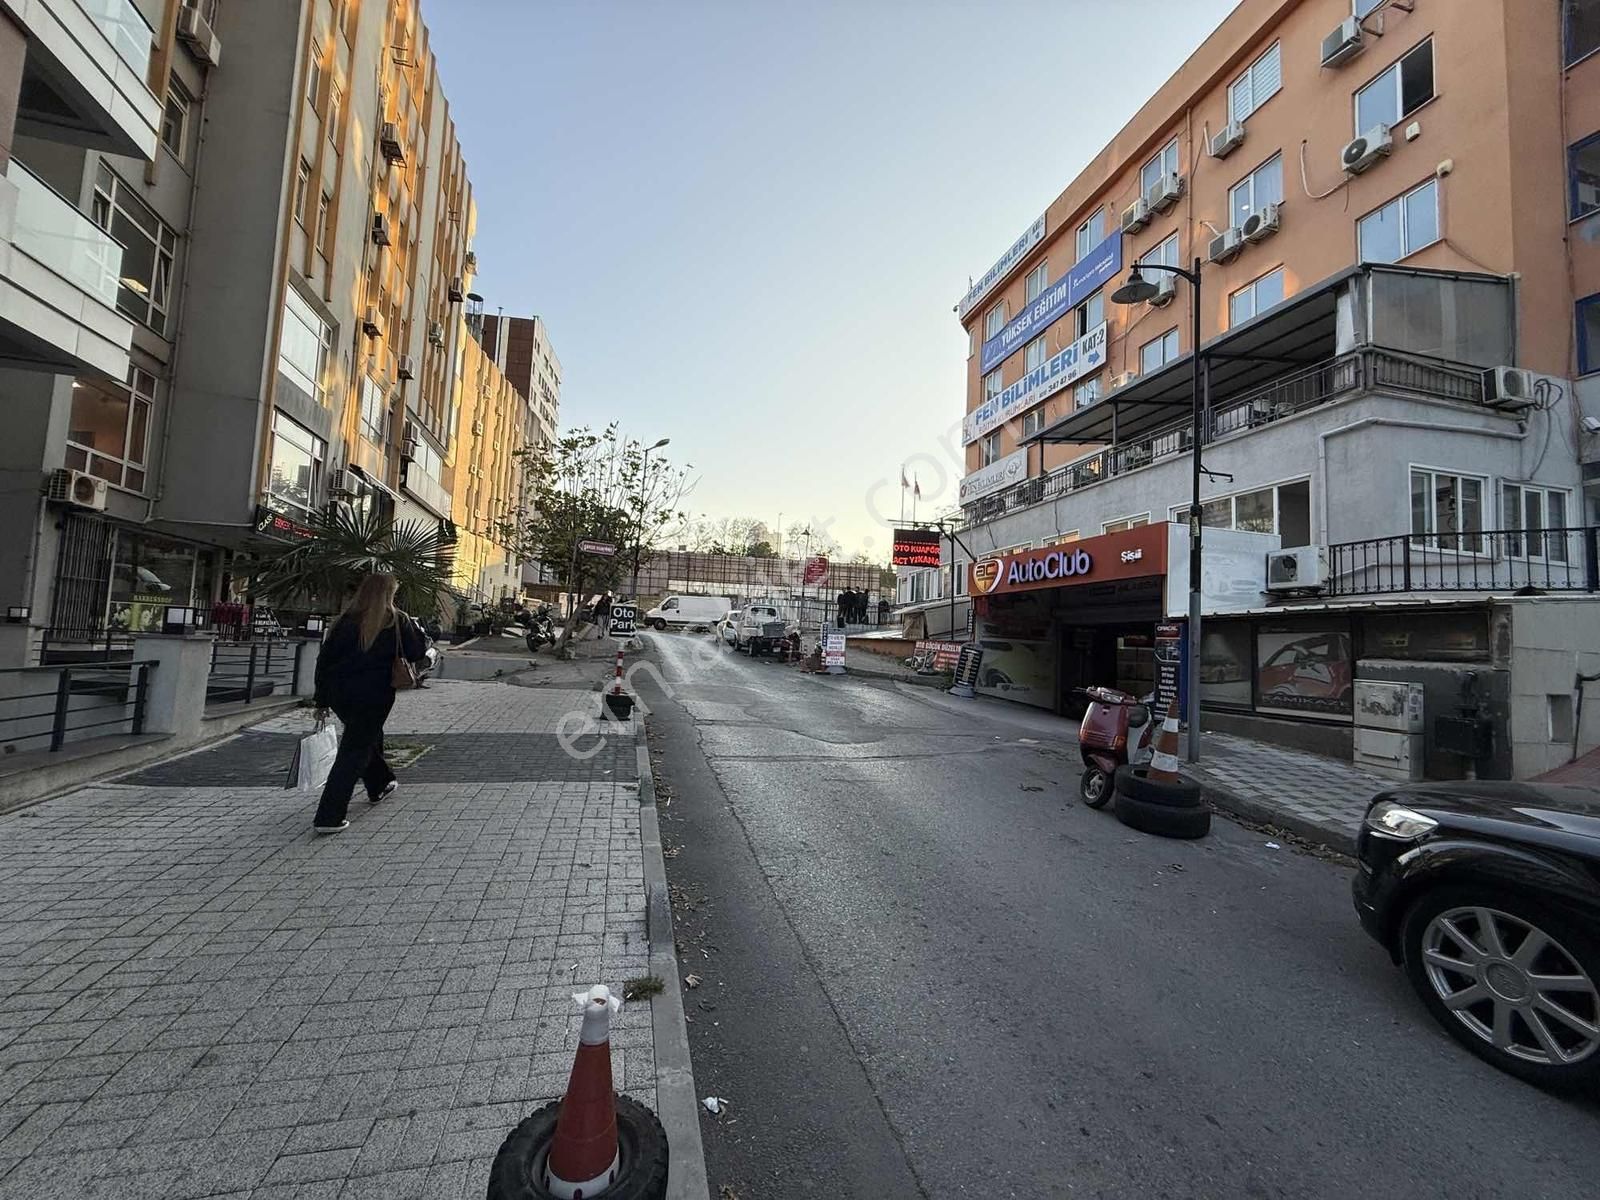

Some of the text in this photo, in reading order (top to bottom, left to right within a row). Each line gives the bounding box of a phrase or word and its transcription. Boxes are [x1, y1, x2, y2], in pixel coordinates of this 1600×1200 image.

[1001, 310, 1033, 346] YÜKSEK
[1034, 283, 1067, 322] EĞİTİM
[975, 399, 999, 426] FEN
[1002, 344, 1078, 408] BİLİMLERİ
[894, 544, 910, 553] OTO
[1120, 548, 1142, 563] Şişli
[1007, 548, 1091, 585] AutoClub
[613, 607, 635, 618] Oto
[610, 619, 637, 630] Park
